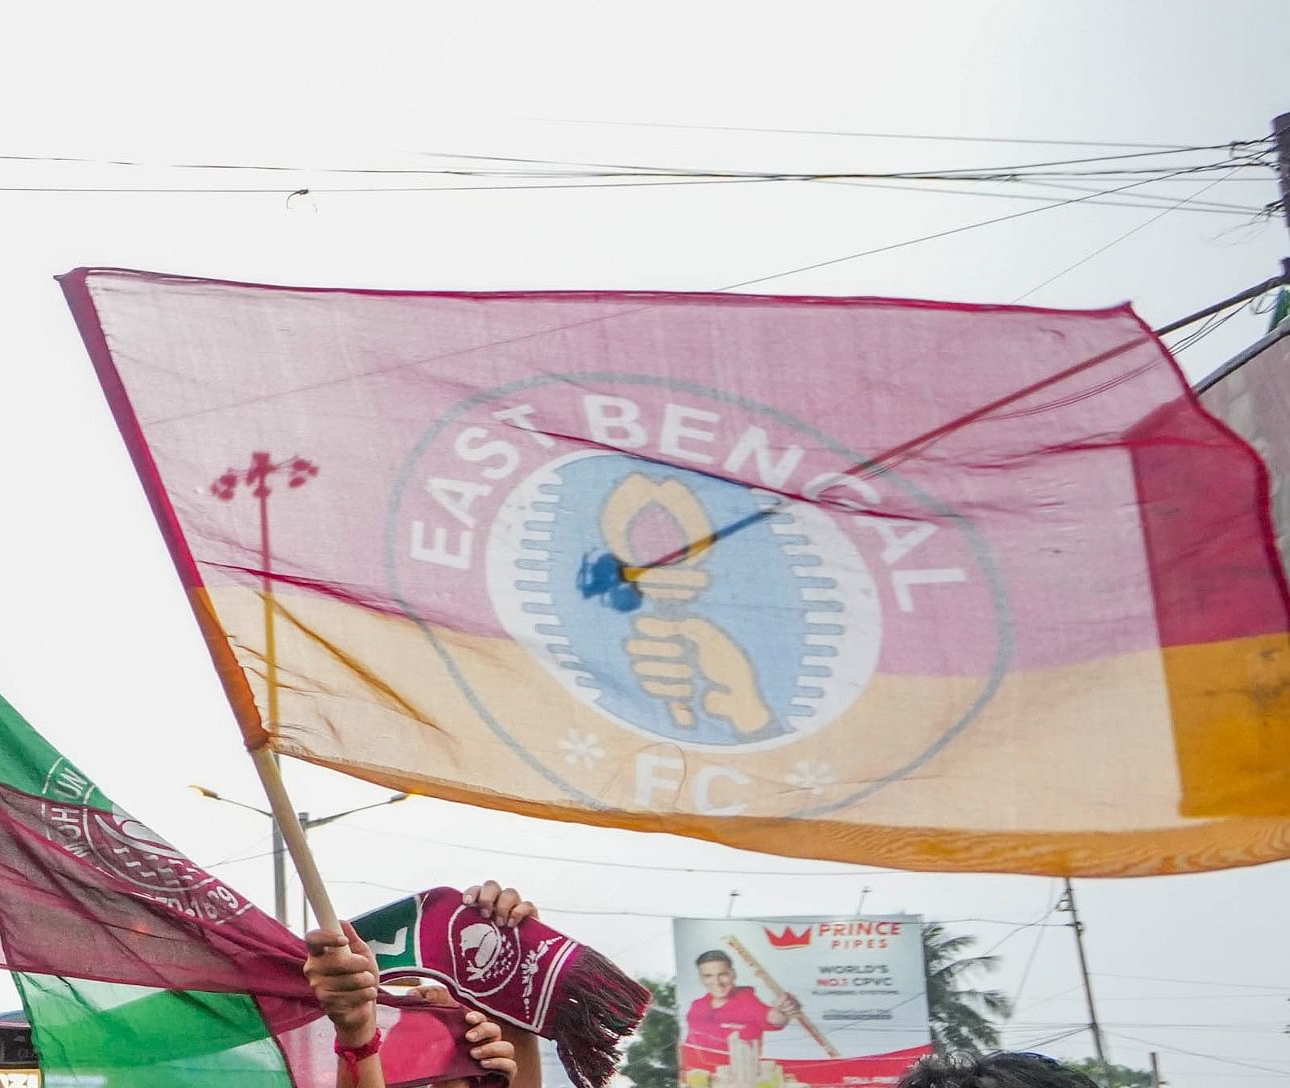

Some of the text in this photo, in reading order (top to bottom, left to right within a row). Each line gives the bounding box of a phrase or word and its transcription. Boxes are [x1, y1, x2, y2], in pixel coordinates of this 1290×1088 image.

[410, 394, 970, 612] EAST BENGAL
[634, 752, 753, 817] FC
[819, 922, 903, 936] PRINCE
[831, 939, 888, 950] PIPES
